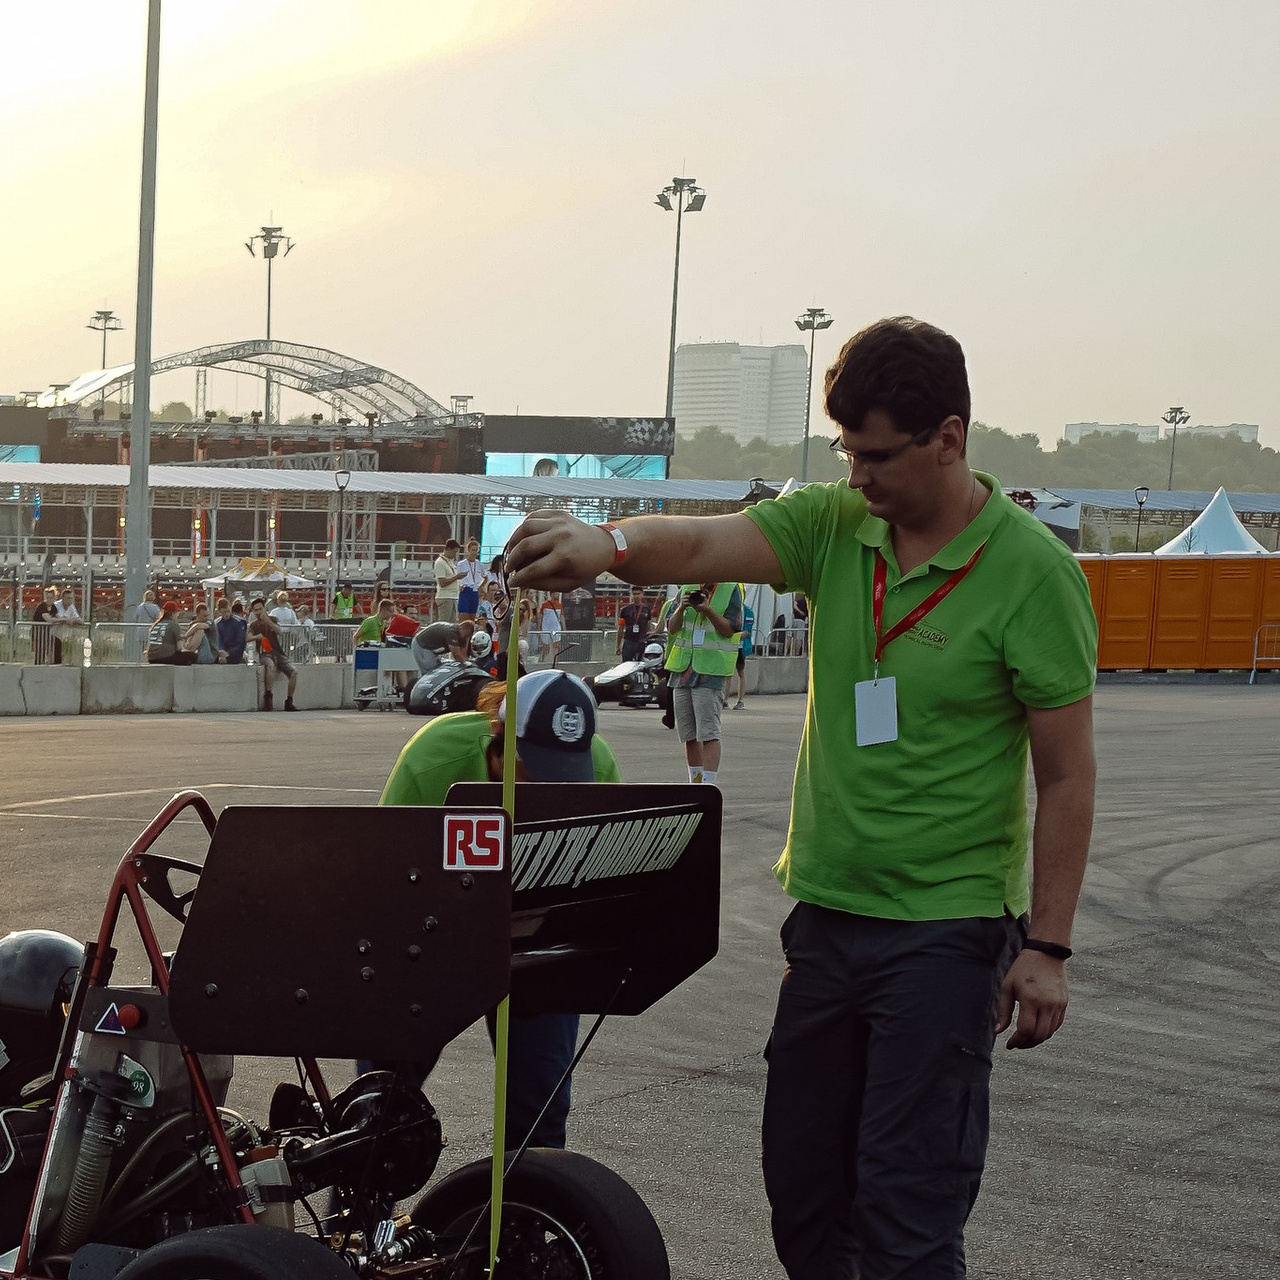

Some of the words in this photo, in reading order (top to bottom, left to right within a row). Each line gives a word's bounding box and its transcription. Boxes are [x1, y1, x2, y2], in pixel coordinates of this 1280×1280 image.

[447, 819, 500, 866] RS
[515, 829, 568, 891] BY
[541, 825, 600, 888] THE
[572, 812, 704, 888] QUARANTEAM
